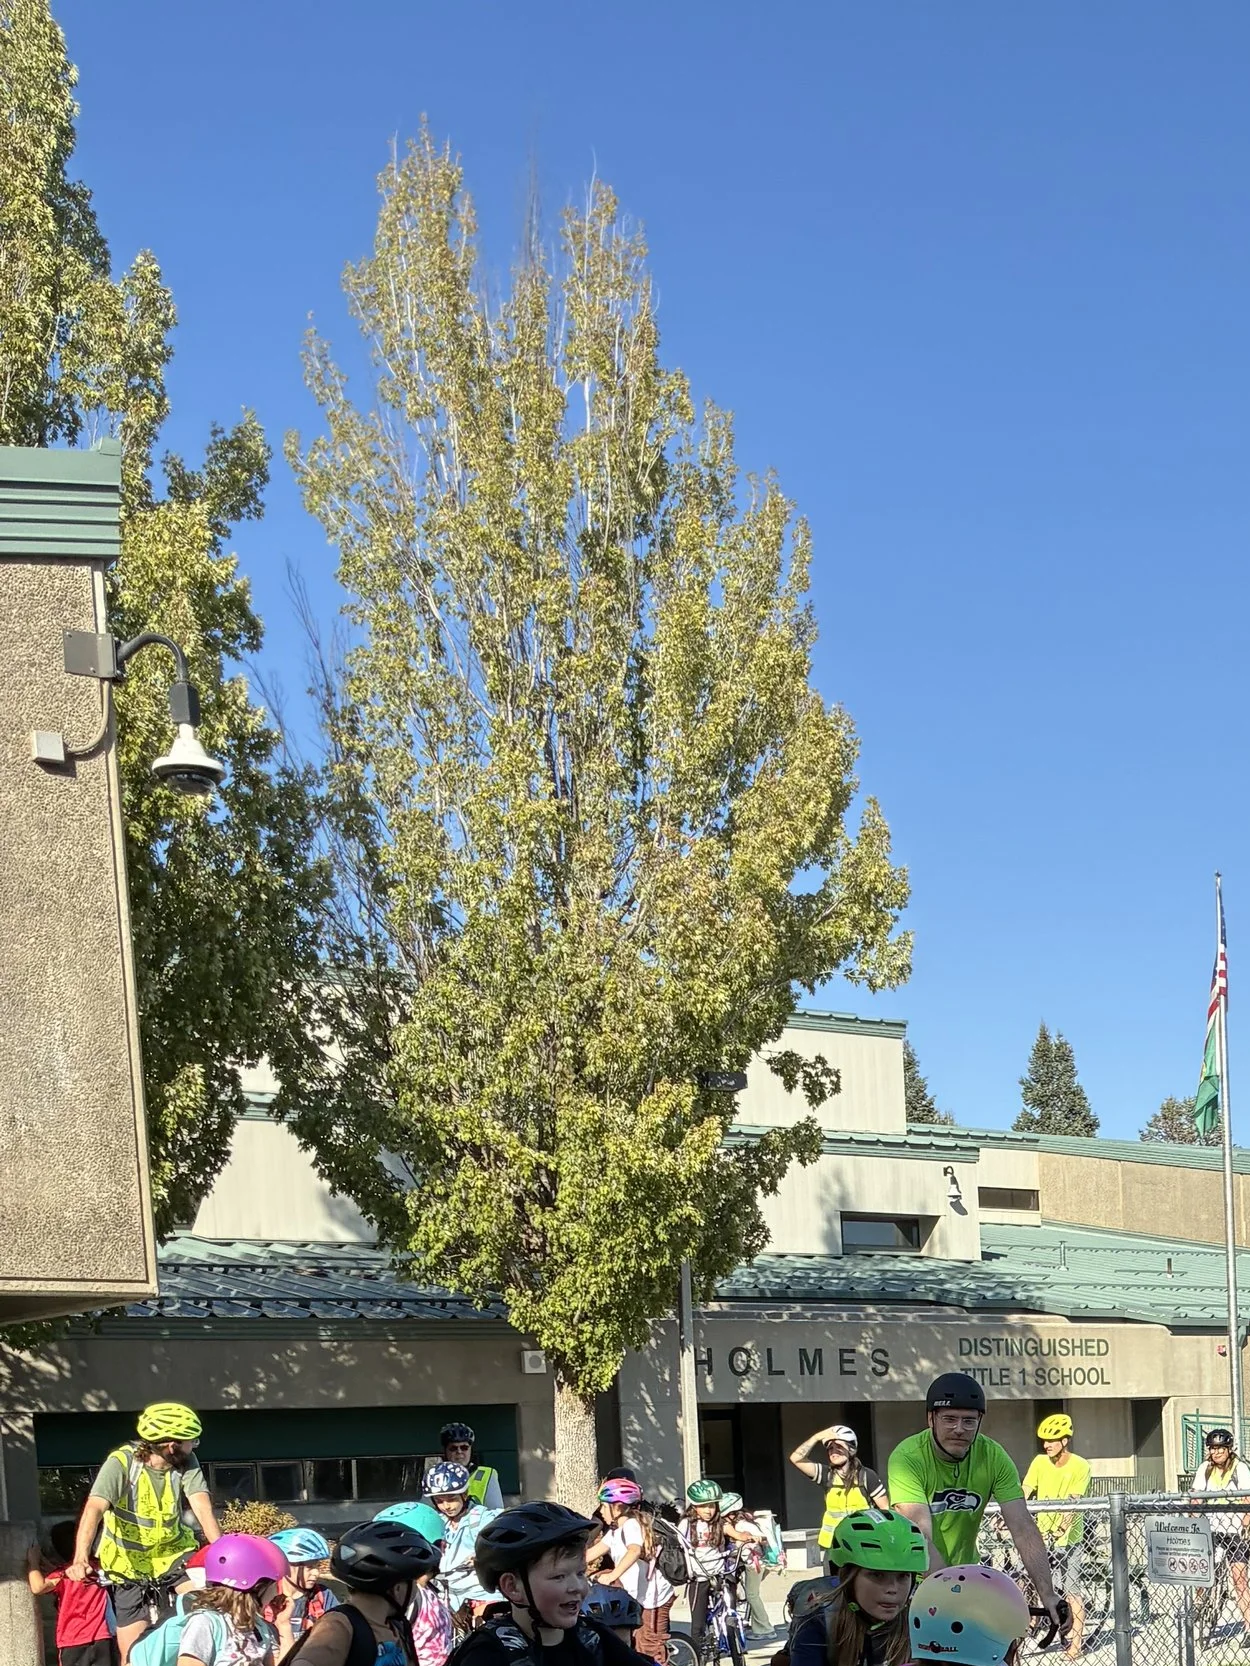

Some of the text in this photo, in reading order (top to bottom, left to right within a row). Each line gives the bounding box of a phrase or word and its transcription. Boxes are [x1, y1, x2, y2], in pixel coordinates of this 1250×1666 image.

[959, 1338, 1109, 1356] DISTINGUISHED
[694, 1346, 890, 1377] HOLMES
[1018, 1368, 1027, 1386] 1
[1035, 1367, 1111, 1386] SCHOOL
[1155, 1521, 1189, 1533] Welcome
